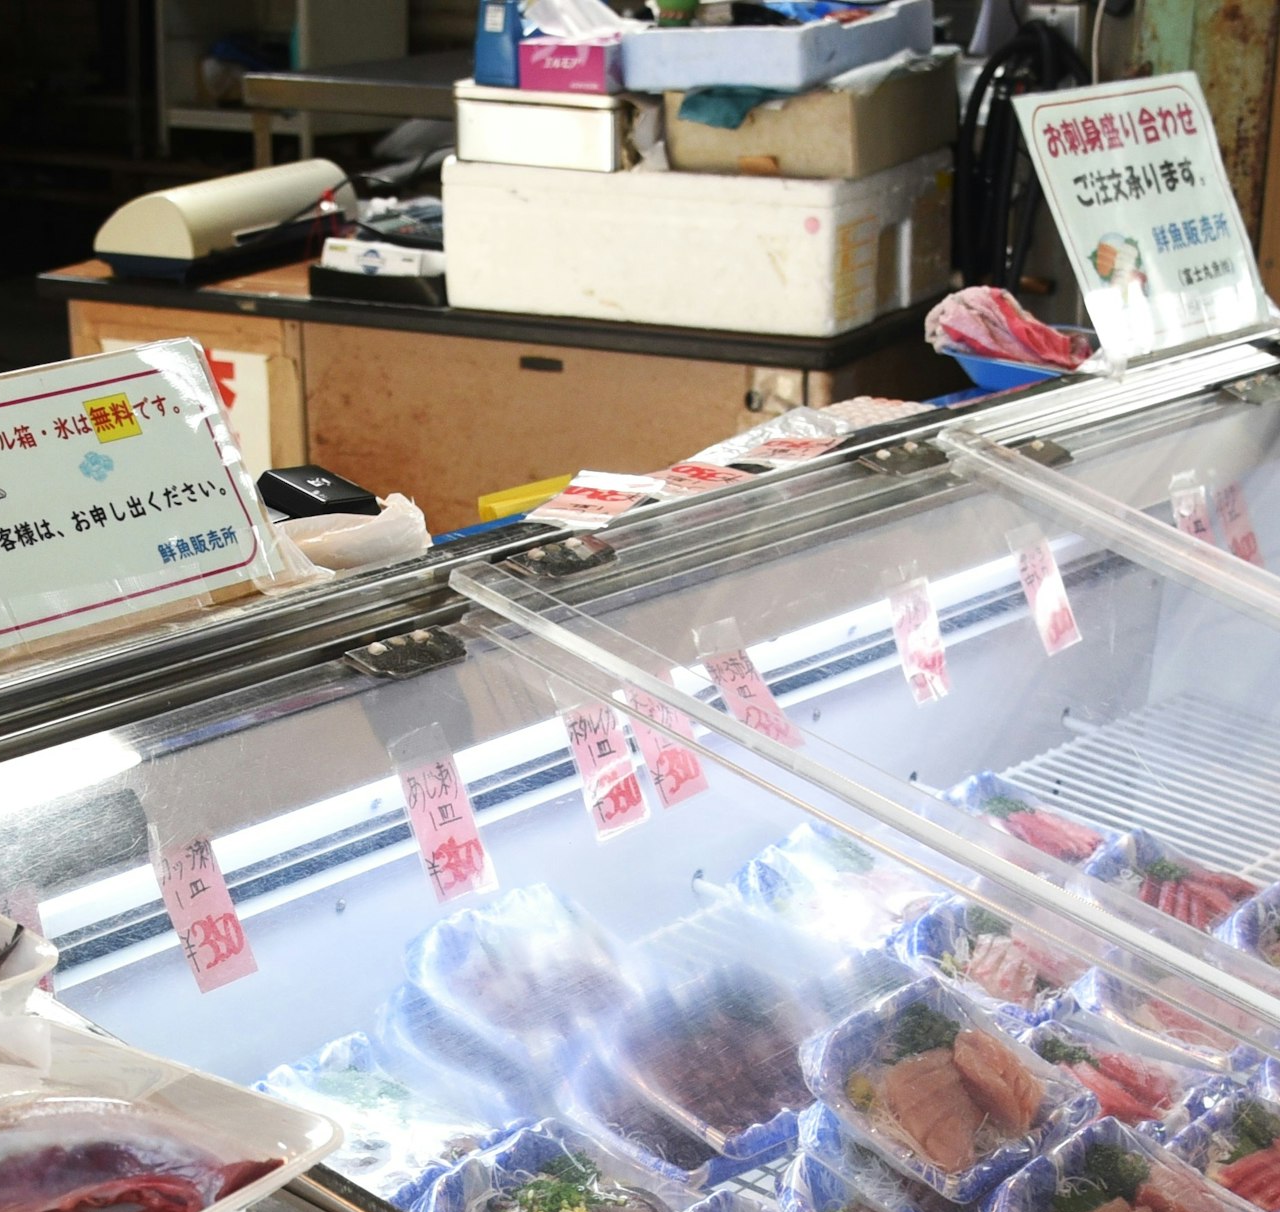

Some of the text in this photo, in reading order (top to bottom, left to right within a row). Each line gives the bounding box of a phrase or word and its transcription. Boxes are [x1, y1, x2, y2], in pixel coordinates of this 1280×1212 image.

[1042, 103, 1198, 158] お刺身盛り合わせ
[1073, 157, 1206, 207] ご注文承ります。
[1151, 213, 1231, 254] 鮮魚販売所
[157, 525, 239, 565] 鮮魚販売所
